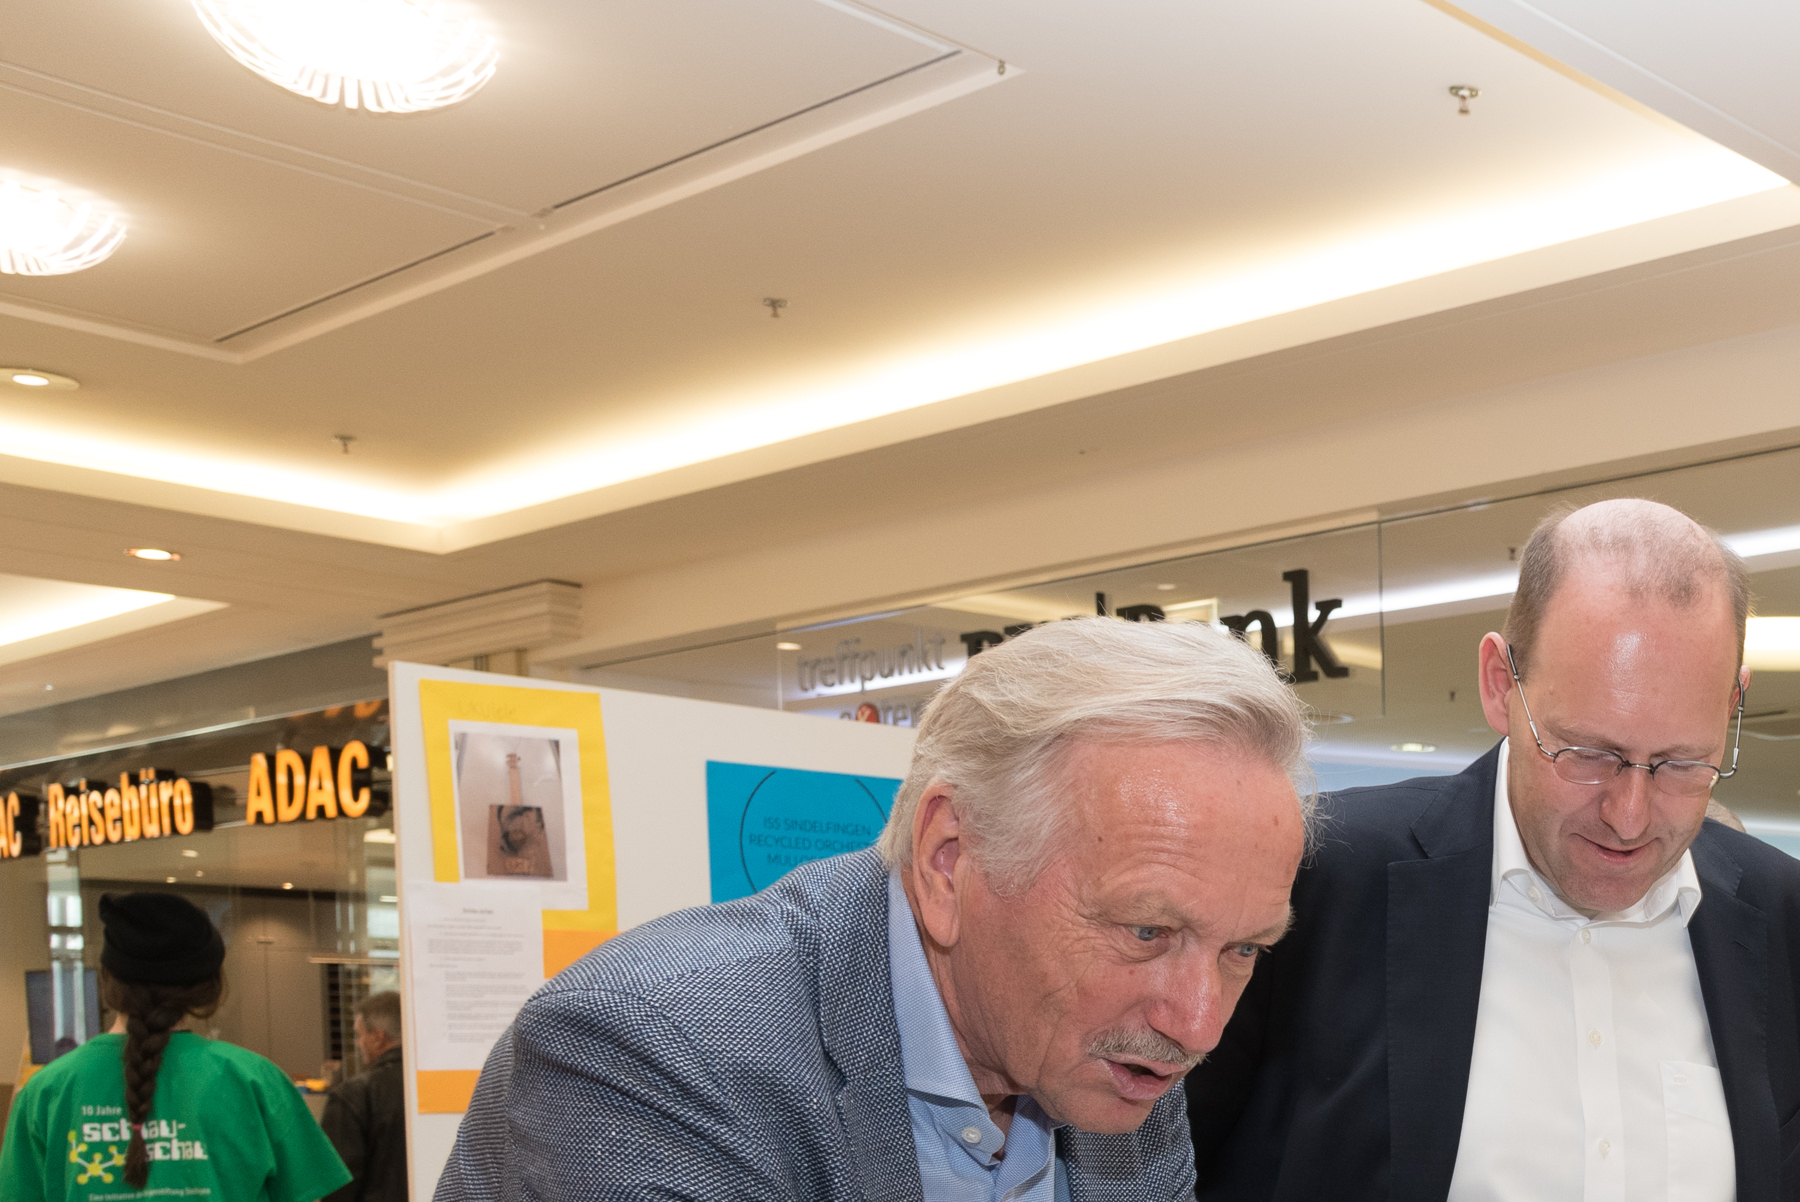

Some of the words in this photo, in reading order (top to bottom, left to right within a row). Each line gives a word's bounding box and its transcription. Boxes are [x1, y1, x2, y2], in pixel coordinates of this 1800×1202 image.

[797, 628, 947, 694] treffpunkt
[48, 767, 195, 850] Reisebüro
[246, 740, 371, 826] ADAC
[784, 819, 872, 837] SINDELFINGEN
[750, 834, 812, 850] RECYCLED
[96, 1106, 122, 1116] Jahre
